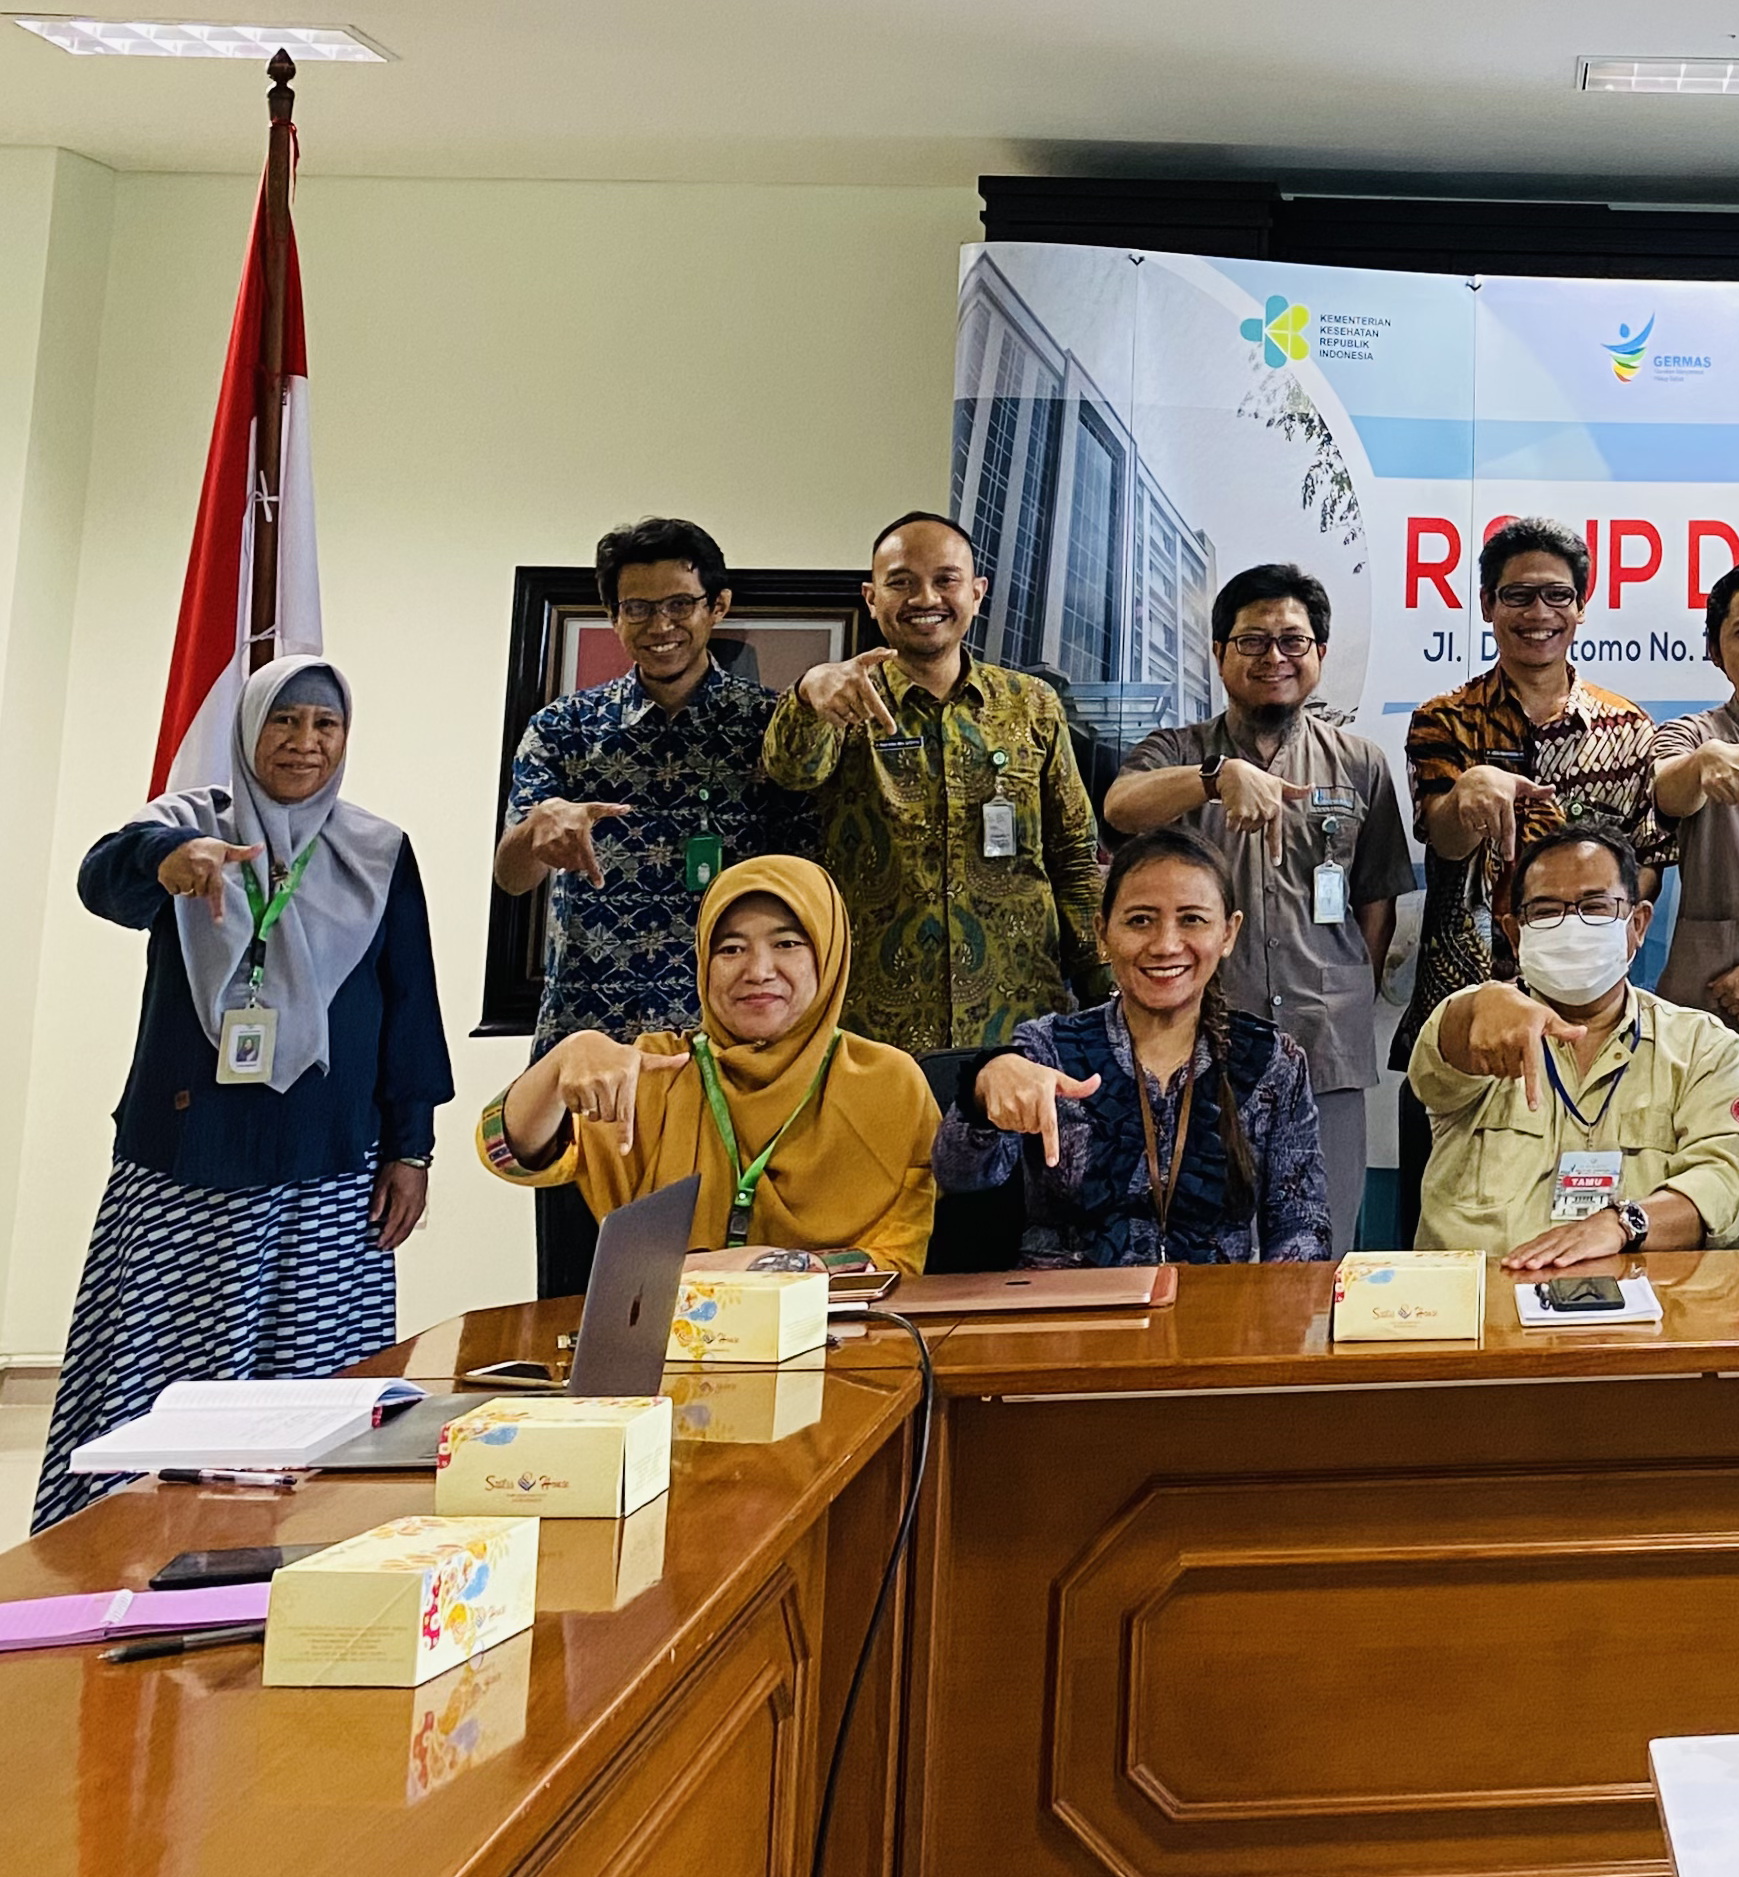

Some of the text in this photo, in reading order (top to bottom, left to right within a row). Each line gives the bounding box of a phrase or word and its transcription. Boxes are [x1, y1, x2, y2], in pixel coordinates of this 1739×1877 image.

[1320, 314, 1391, 327] KEMENTERIAN
[1320, 326, 1379, 337] KESEHATAN
[1319, 337, 1370, 348] REPUBLIK
[1319, 349, 1374, 360] INDONESIA
[1653, 355, 1712, 368] GERMAS
[1405, 515, 1663, 609] RP
[1423, 631, 1462, 662] Jl.
[1650, 631, 1694, 661] No.
[1571, 1178, 1603, 1187] TAMU
